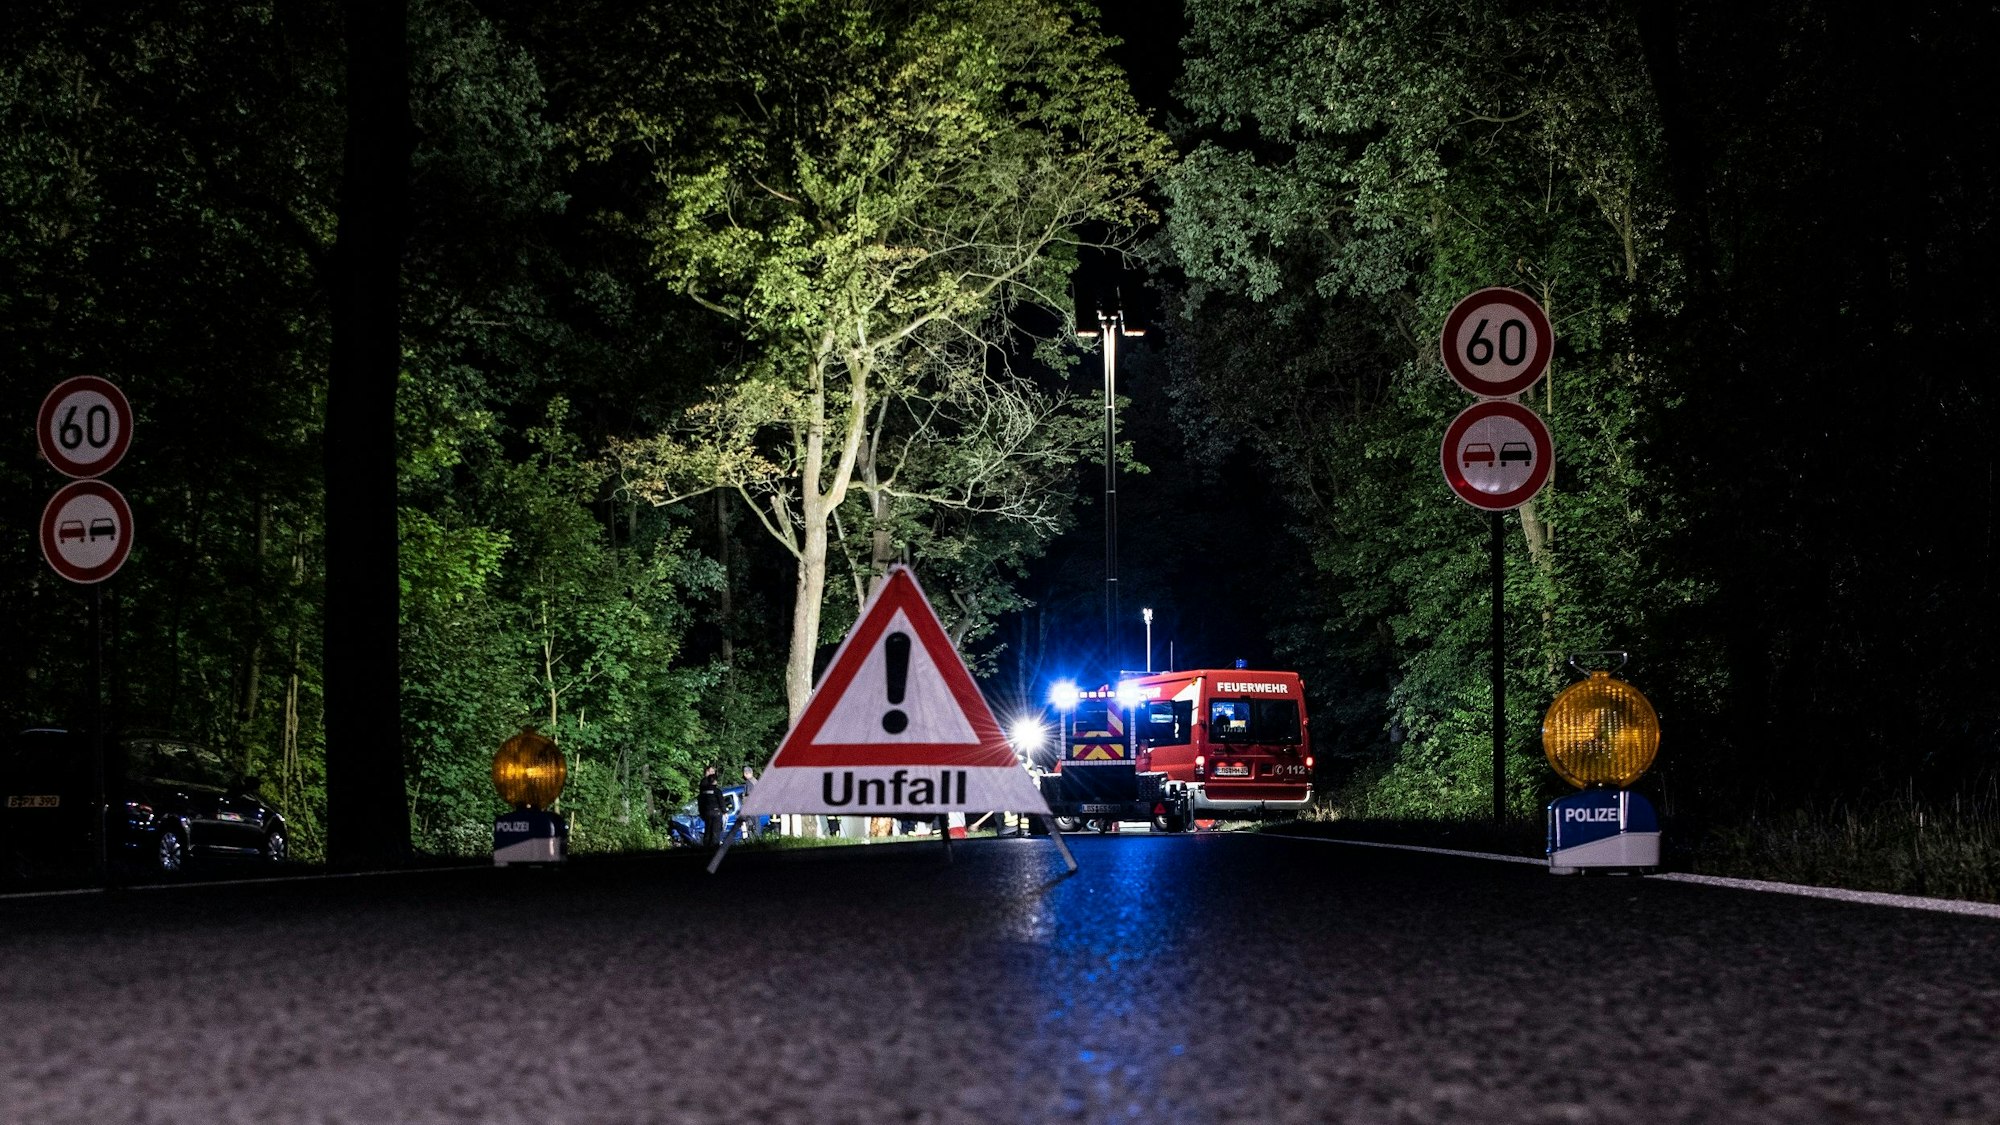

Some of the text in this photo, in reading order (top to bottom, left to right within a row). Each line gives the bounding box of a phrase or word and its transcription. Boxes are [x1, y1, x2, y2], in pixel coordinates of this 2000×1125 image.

[1467, 319, 1526, 365] 60
[60, 405, 109, 449] 60
[1217, 682, 1287, 692] FEUERWEHR
[1286, 764, 1305, 774] 112
[823, 770, 967, 806] Unfall
[1565, 808, 1620, 822] POLIZEI
[496, 821, 530, 832] POLIZEI
